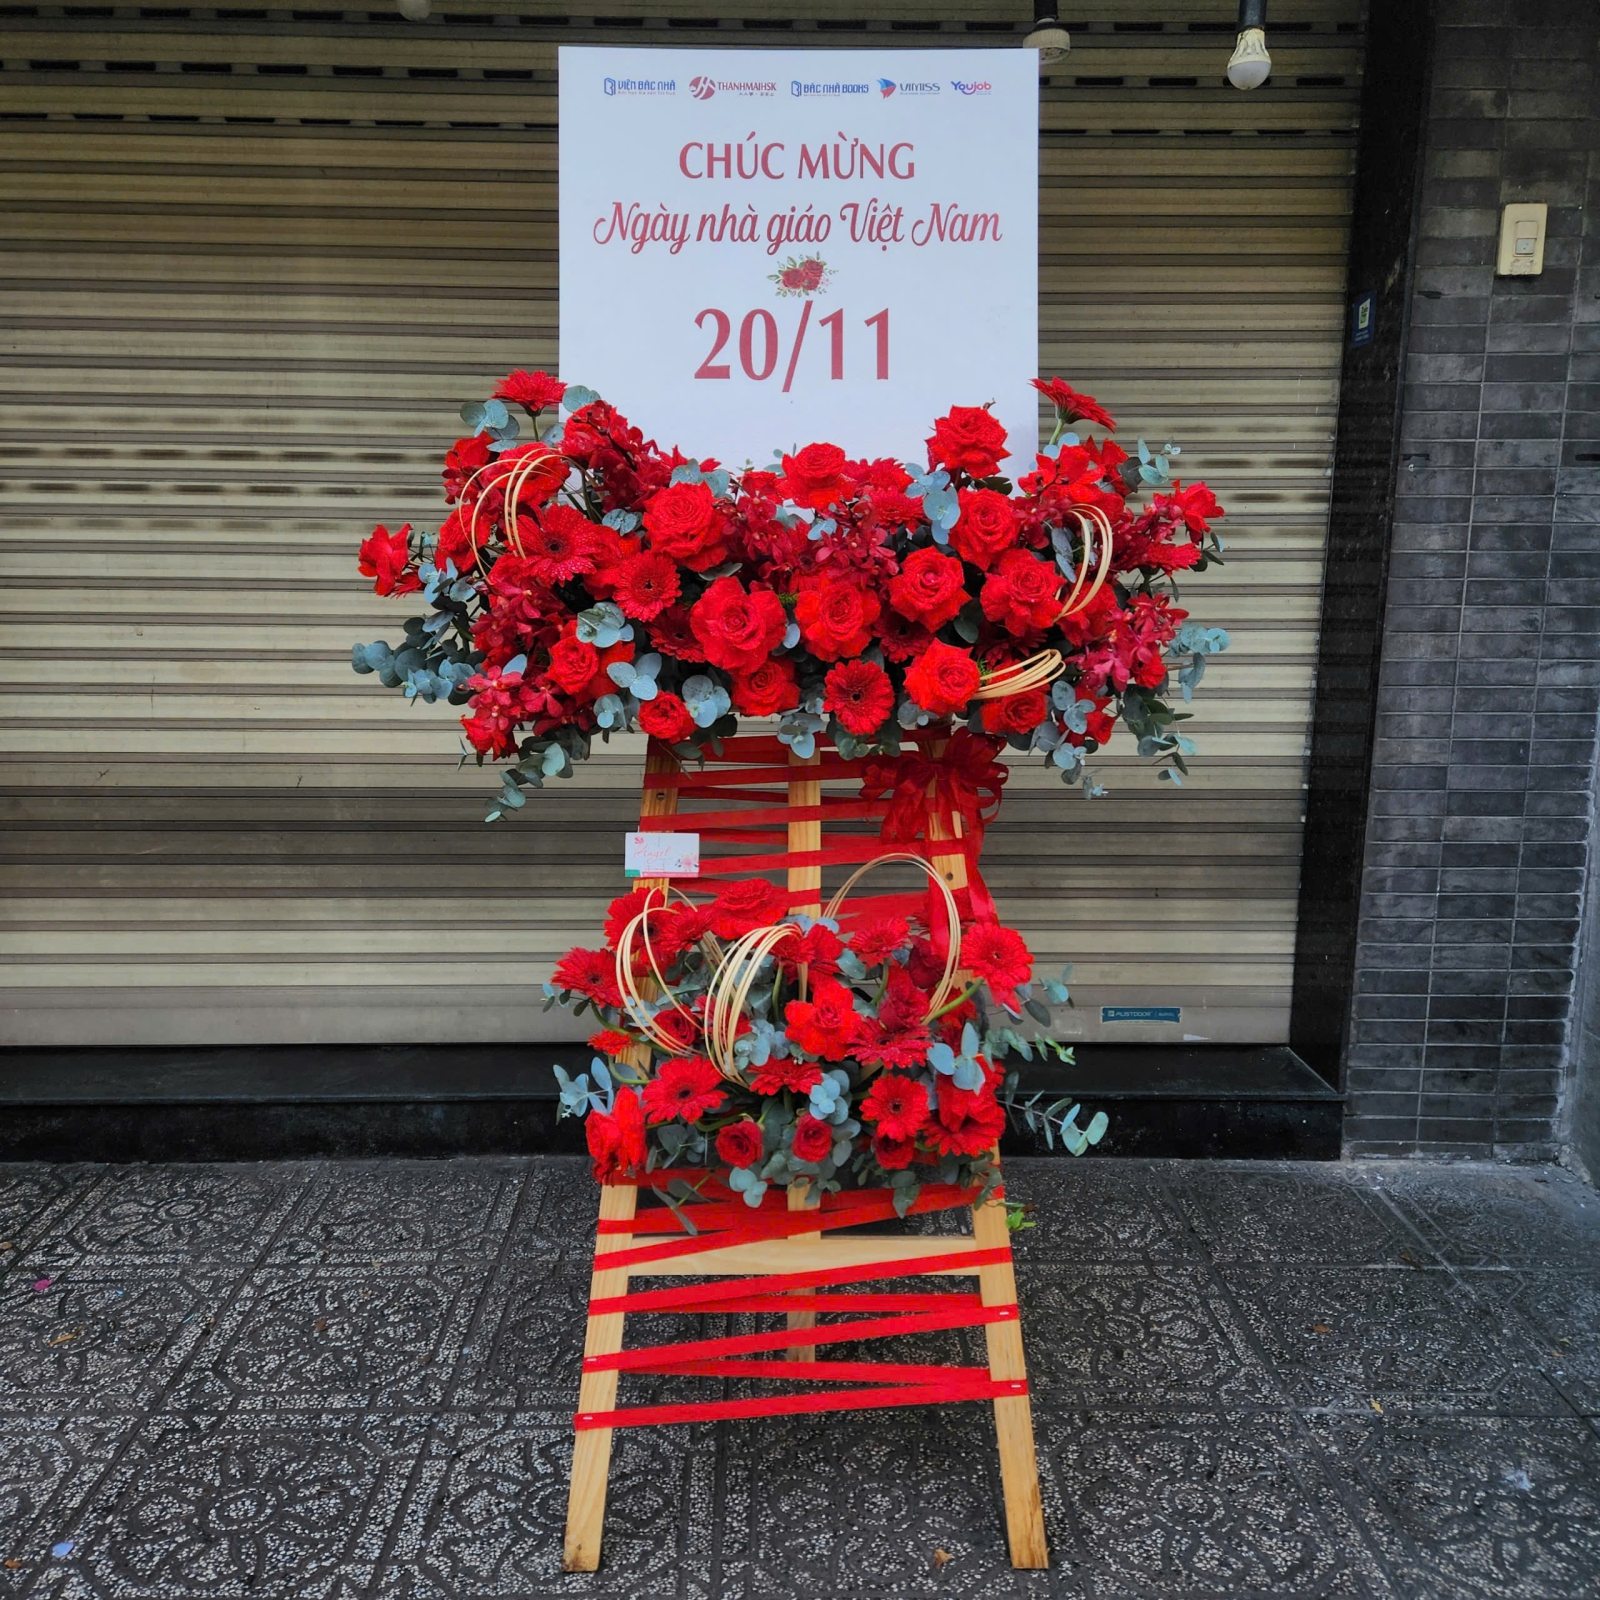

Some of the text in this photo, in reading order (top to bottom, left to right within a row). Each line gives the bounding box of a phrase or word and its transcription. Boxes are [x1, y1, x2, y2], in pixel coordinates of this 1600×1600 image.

[717, 81, 777, 91] THANHMAIHSK
[842, 84, 869, 94] BOOKS
[900, 82, 941, 92] VIMISS
[950, 81, 992, 95] Youjob
[679, 131, 915, 180] CHÚC MỪNG
[593, 197, 1003, 255] Ngày nhà giáo Việt Nam
[694, 300, 889, 393] 20/11
